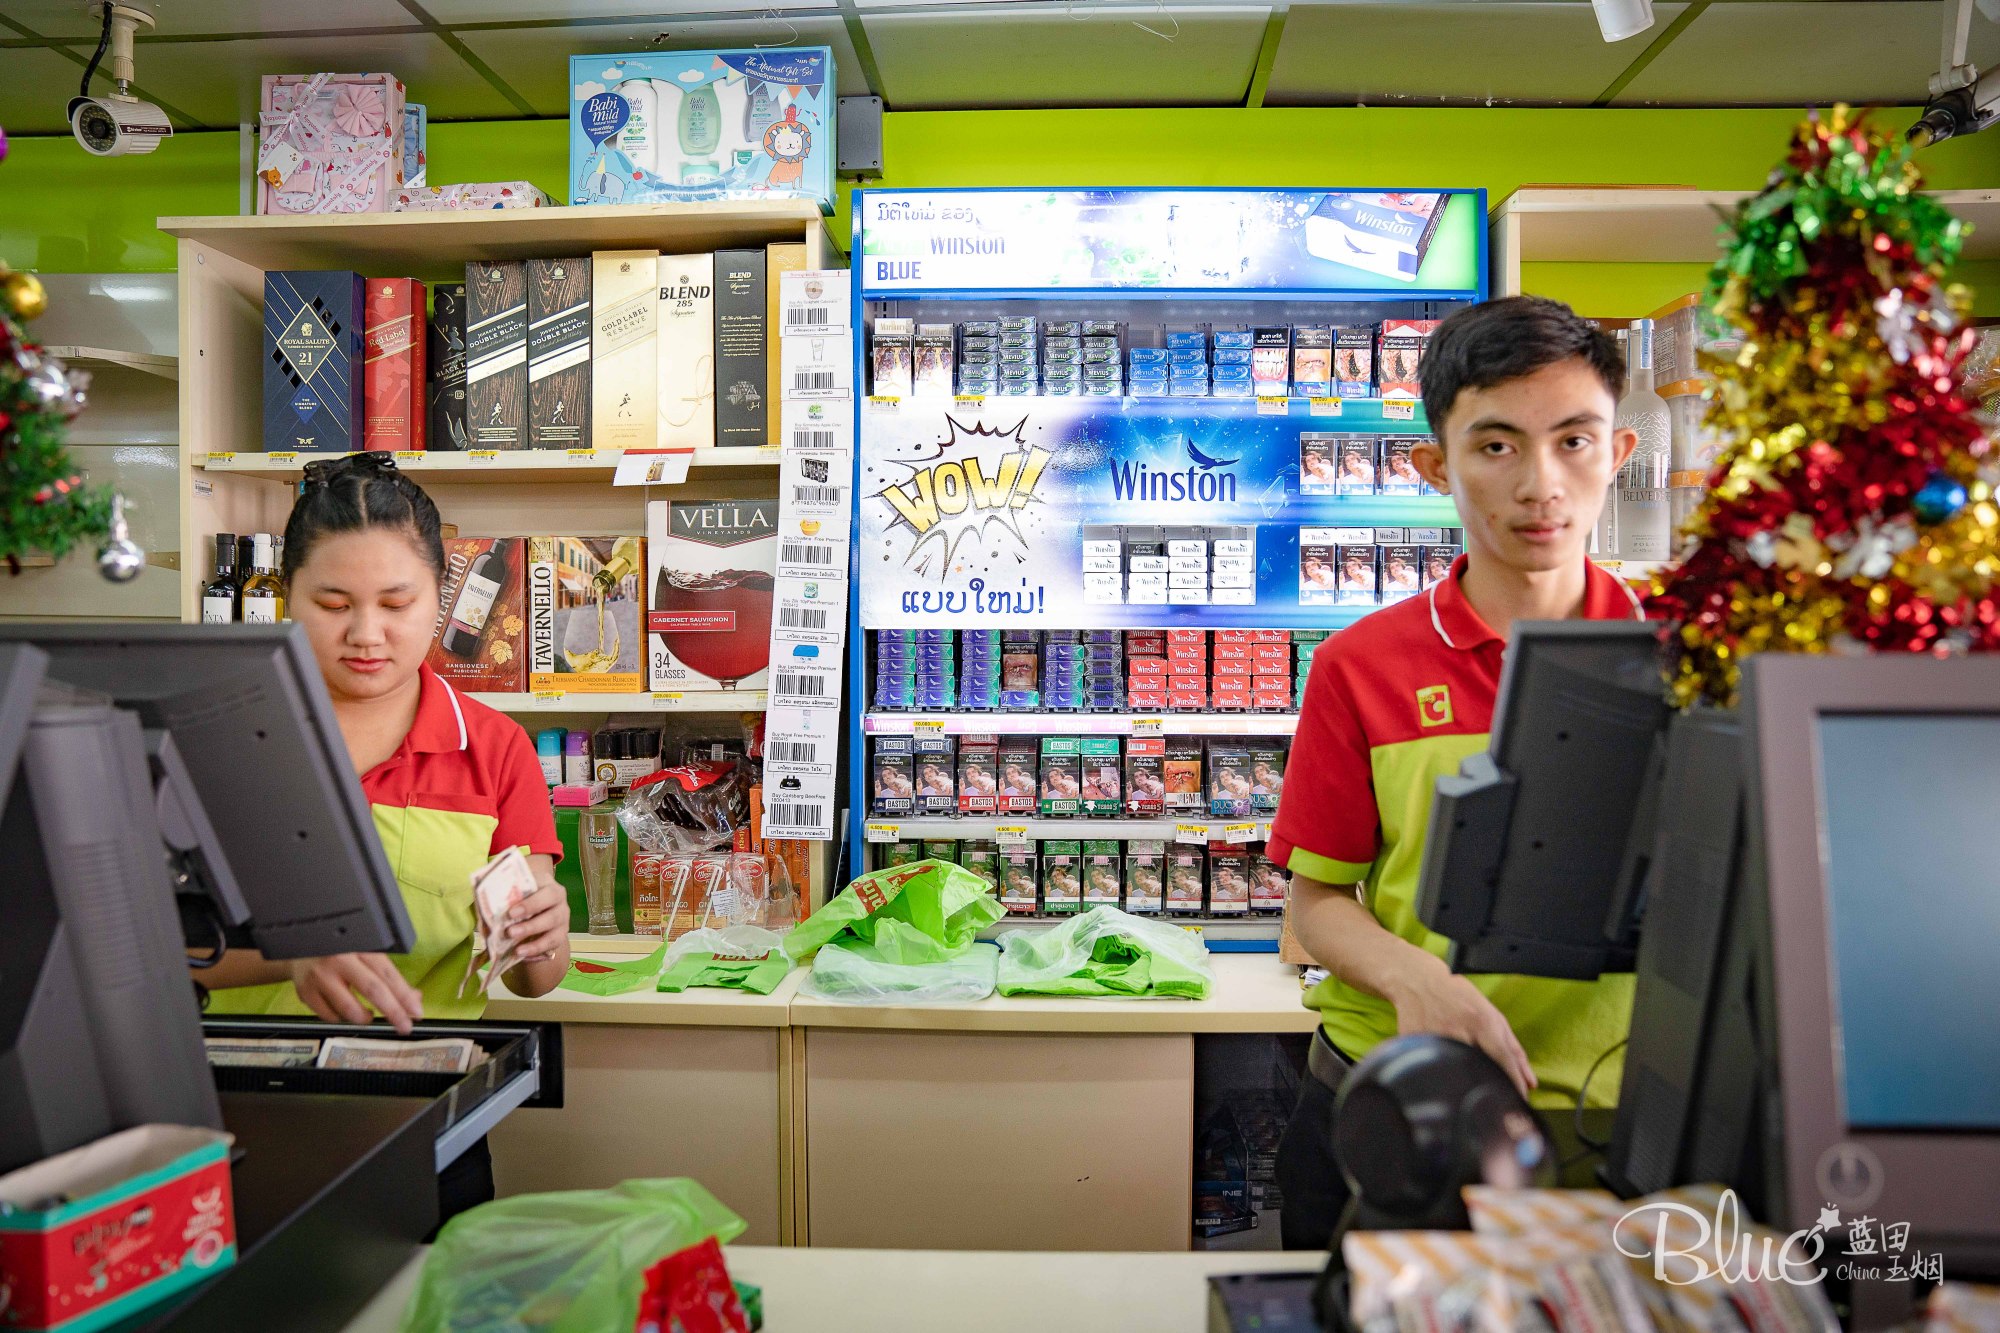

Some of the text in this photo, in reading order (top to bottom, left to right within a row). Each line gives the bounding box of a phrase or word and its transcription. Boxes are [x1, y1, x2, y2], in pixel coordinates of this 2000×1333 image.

[745, 56, 756, 66] The
[759, 62, 786, 73] Natural
[801, 67, 814, 76] Set
[588, 97, 618, 113] Babi
[1354, 208, 1414, 237] Winston
[730, 271, 752, 280] BLEND
[878, 262, 922, 281] BLUE
[660, 286, 711, 300] BLEND
[670, 308, 696, 317] Signature
[602, 306, 649, 332] GOLD LABEL
[607, 317, 647, 338] RESERVE
[369, 329, 406, 347] Red Label
[470, 334, 499, 349] DOUBLE
[531, 332, 561, 347] DOUBLE
[299, 353, 313, 363] 21
[436, 365, 458, 378] BLACK
[1306, 386, 1326, 394] Winston
[1346, 386, 1366, 394] Winston
[1109, 456, 1236, 502] Winston
[881, 444, 1054, 535] WOW!
[533, 565, 552, 669] TAVERNELLO
[1175, 634, 1198, 642] Winston
[1222, 634, 1244, 642] Winston
[1133, 645, 1155, 653] Winston
[1259, 649, 1282, 658] Winston
[1176, 650, 1198, 658] Winston
[1221, 650, 1244, 658] Winston
[655, 652, 671, 668] 34
[655, 669, 687, 679] GLASSES
[1137, 666, 1160, 674] Winston
[1175, 666, 1198, 674] Winston
[1136, 682, 1159, 690] Winston
[1220, 682, 1243, 690] Winston
[1260, 682, 1282, 690] Winston
[1135, 697, 1158, 705] Winston
[1175, 697, 1198, 705] Winston
[1219, 697, 1243, 705] Winston
[1260, 697, 1282, 705] Winston
[923, 742, 942, 750] BASTOS
[1052, 742, 1071, 750] BASTOS
[887, 800, 909, 808] BASTOS
[928, 797, 950, 806] BASTOS
[972, 797, 993, 806] BASTOS
[1011, 798, 1032, 806] BASTOS
[1054, 801, 1076, 809] BASTOS
